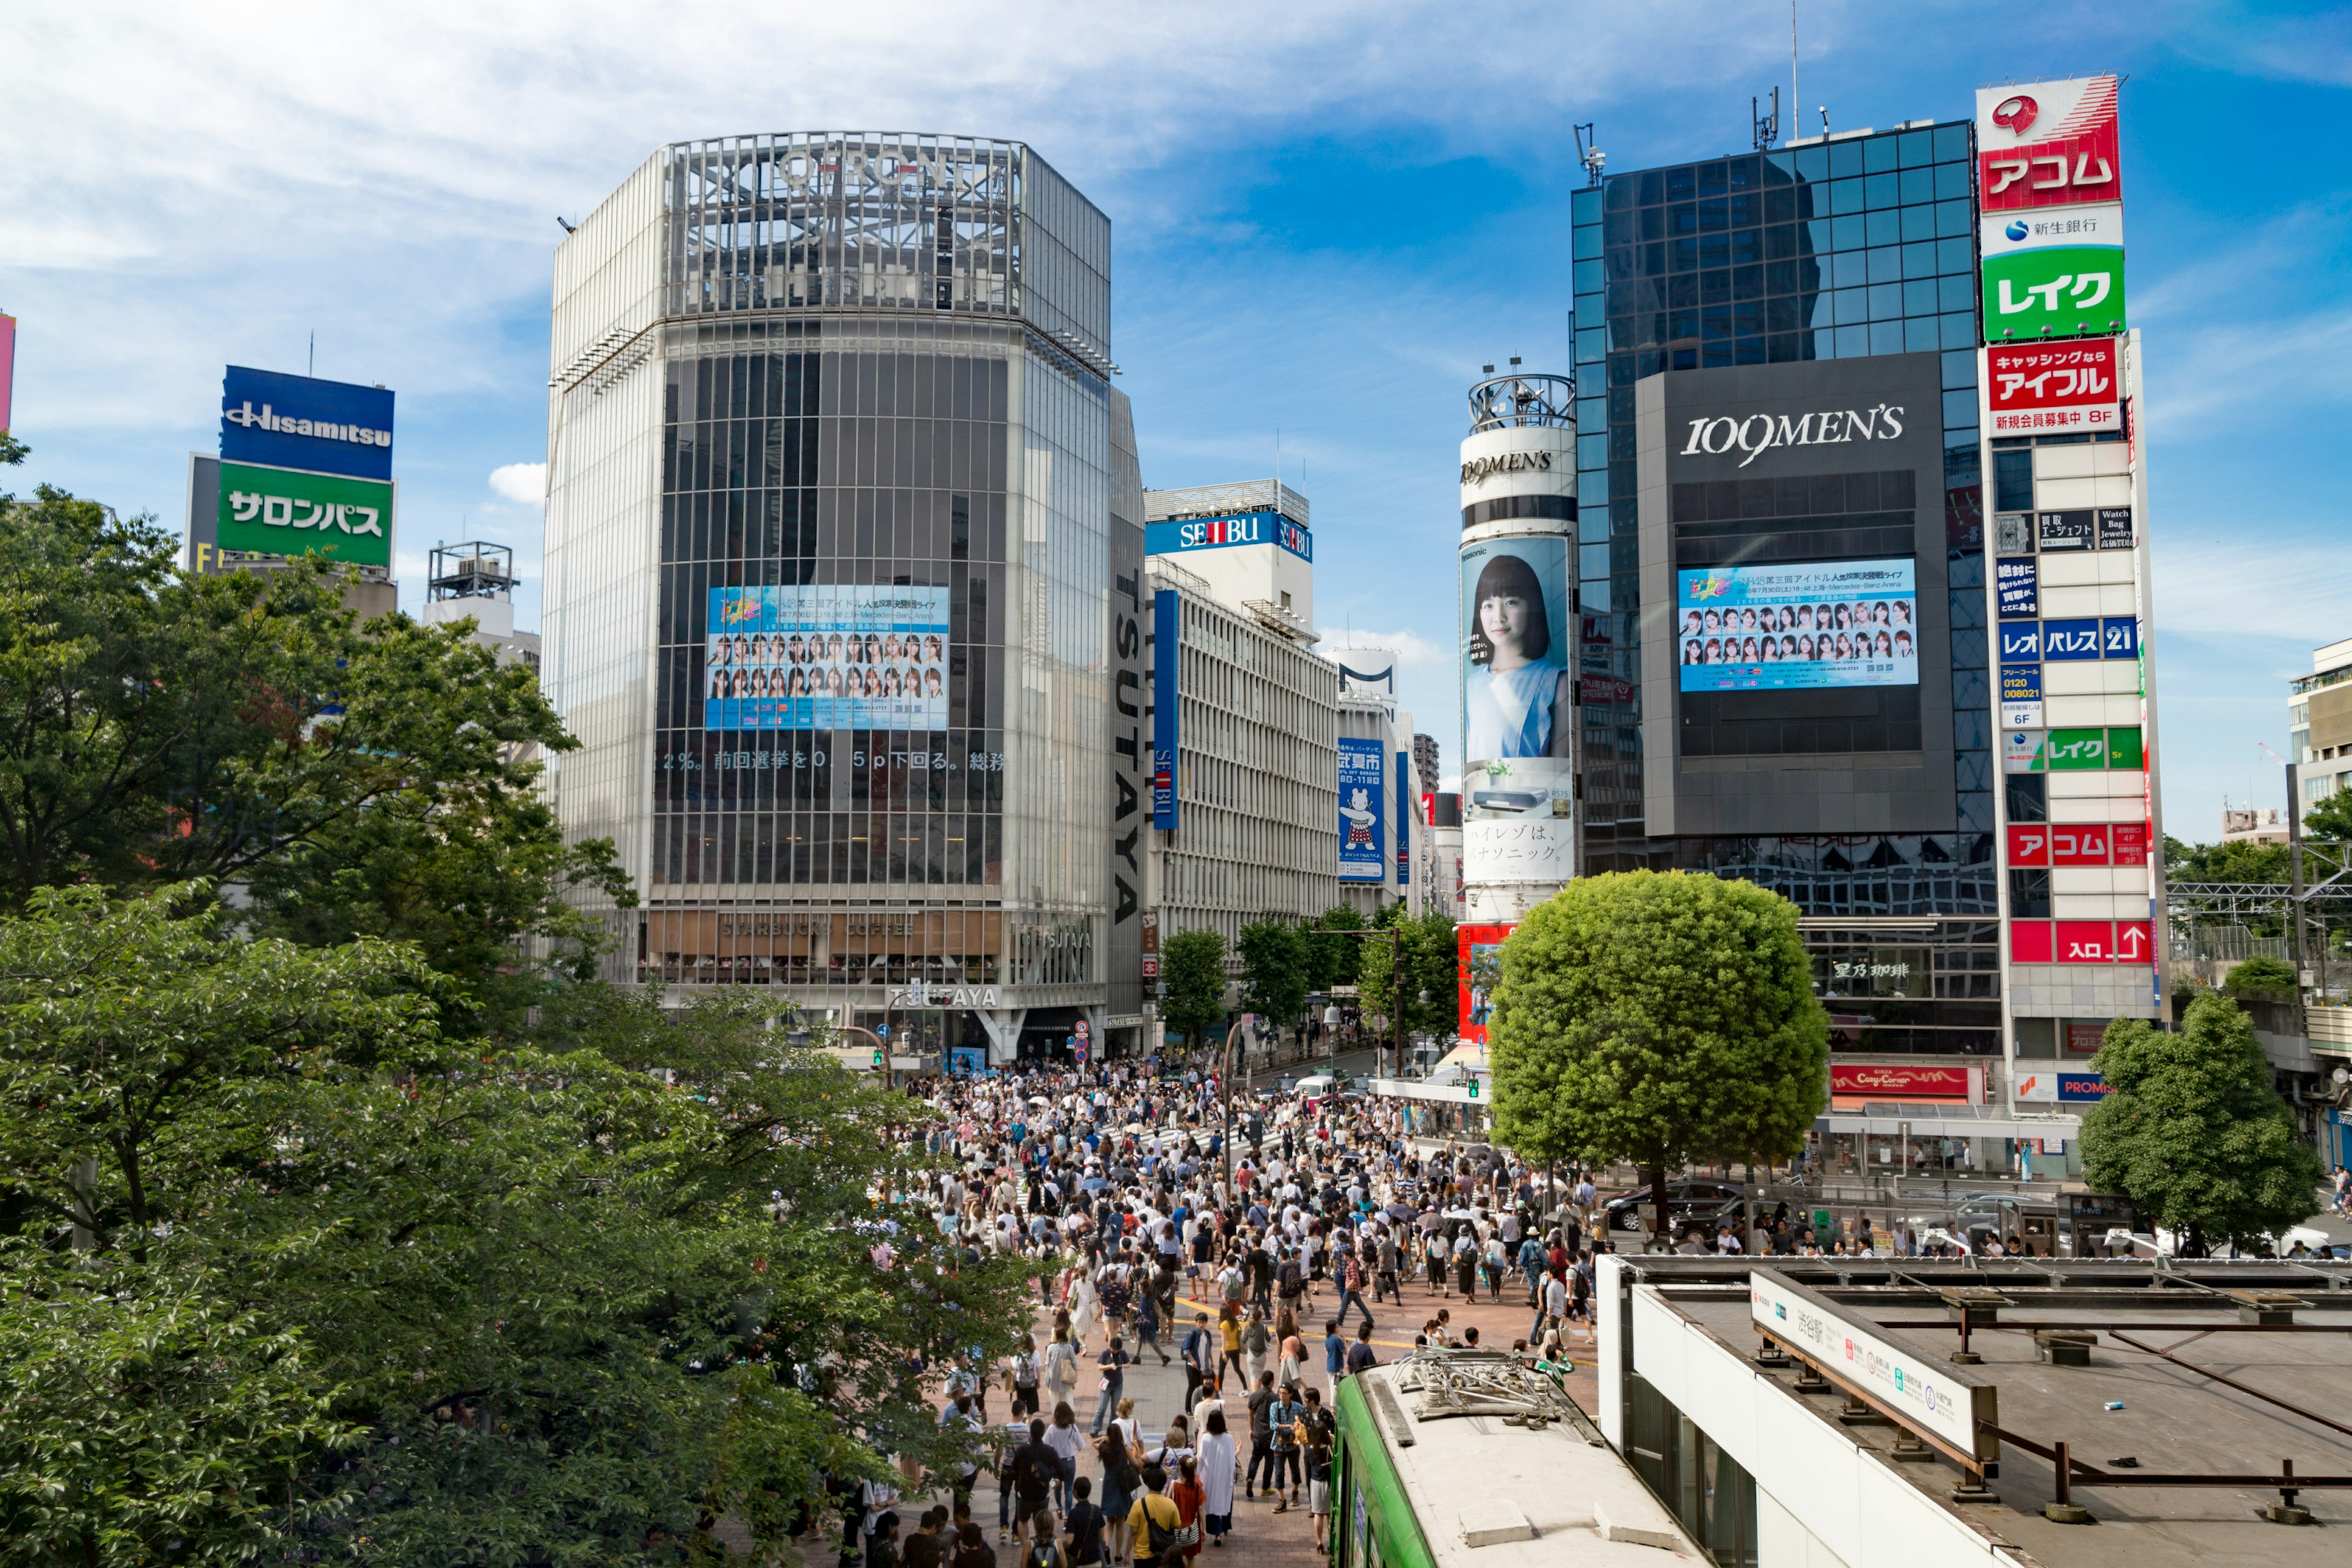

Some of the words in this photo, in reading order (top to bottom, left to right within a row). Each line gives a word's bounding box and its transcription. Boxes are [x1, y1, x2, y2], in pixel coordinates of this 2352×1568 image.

[778, 150, 971, 194] QFRONT
[1989, 151, 2113, 194] アコム
[2034, 218, 2097, 236] 新生銀行
[1998, 271, 2111, 314] レイク
[1996, 350, 2106, 369] キャッシングなら
[1997, 368, 2109, 401] アイフル
[225, 401, 391, 448] Hisamitsu
[1996, 411, 2081, 431] 新規会員募集中
[2089, 410, 2113, 423] 8F
[1680, 403, 1904, 469] 109MEN'S
[229, 491, 382, 537] サロンパス
[2042, 514, 2062, 526] 買取
[2102, 510, 2128, 519] Watch
[1180, 518, 1259, 548] SEIBU
[2042, 525, 2092, 538] エージェント
[2108, 520, 2124, 529] Bag
[1280, 519, 1310, 559] SEIBU
[2100, 529, 2132, 540] Jewelry
[2101, 539, 2133, 548] 高価買取
[1998, 565, 2035, 578] 絶対に
[2002, 603, 2036, 612] ここにある
[2004, 679, 2027, 688] 0120
[2004, 689, 2039, 698] 008021
[2015, 715, 2030, 725] 6F
[1115, 568, 1138, 926] TSUTAYA
[2049, 739, 2103, 760] レイク
[1156, 750, 1171, 814] SEIBU
[1471, 824, 1555, 843] ハイレゾは、
[2019, 834, 2105, 856] アコム
[1398, 840, 1408, 876] SEIBU
[1469, 846, 1561, 862] パナソニック。
[722, 921, 832, 937] STARBUCKS
[845, 922, 914, 937] COFFEE
[1043, 932, 1091, 949] TSUTAYA
[2069, 942, 2101, 959] 入口
[1145, 962, 1155, 973] 本
[1834, 962, 1910, 979] 星乃珈琲
[1108, 1018, 1126, 1027] TSUTAYA
[2065, 1082, 2117, 1093] PROMIS
[1798, 1309, 1823, 1345] 渋谷駅
